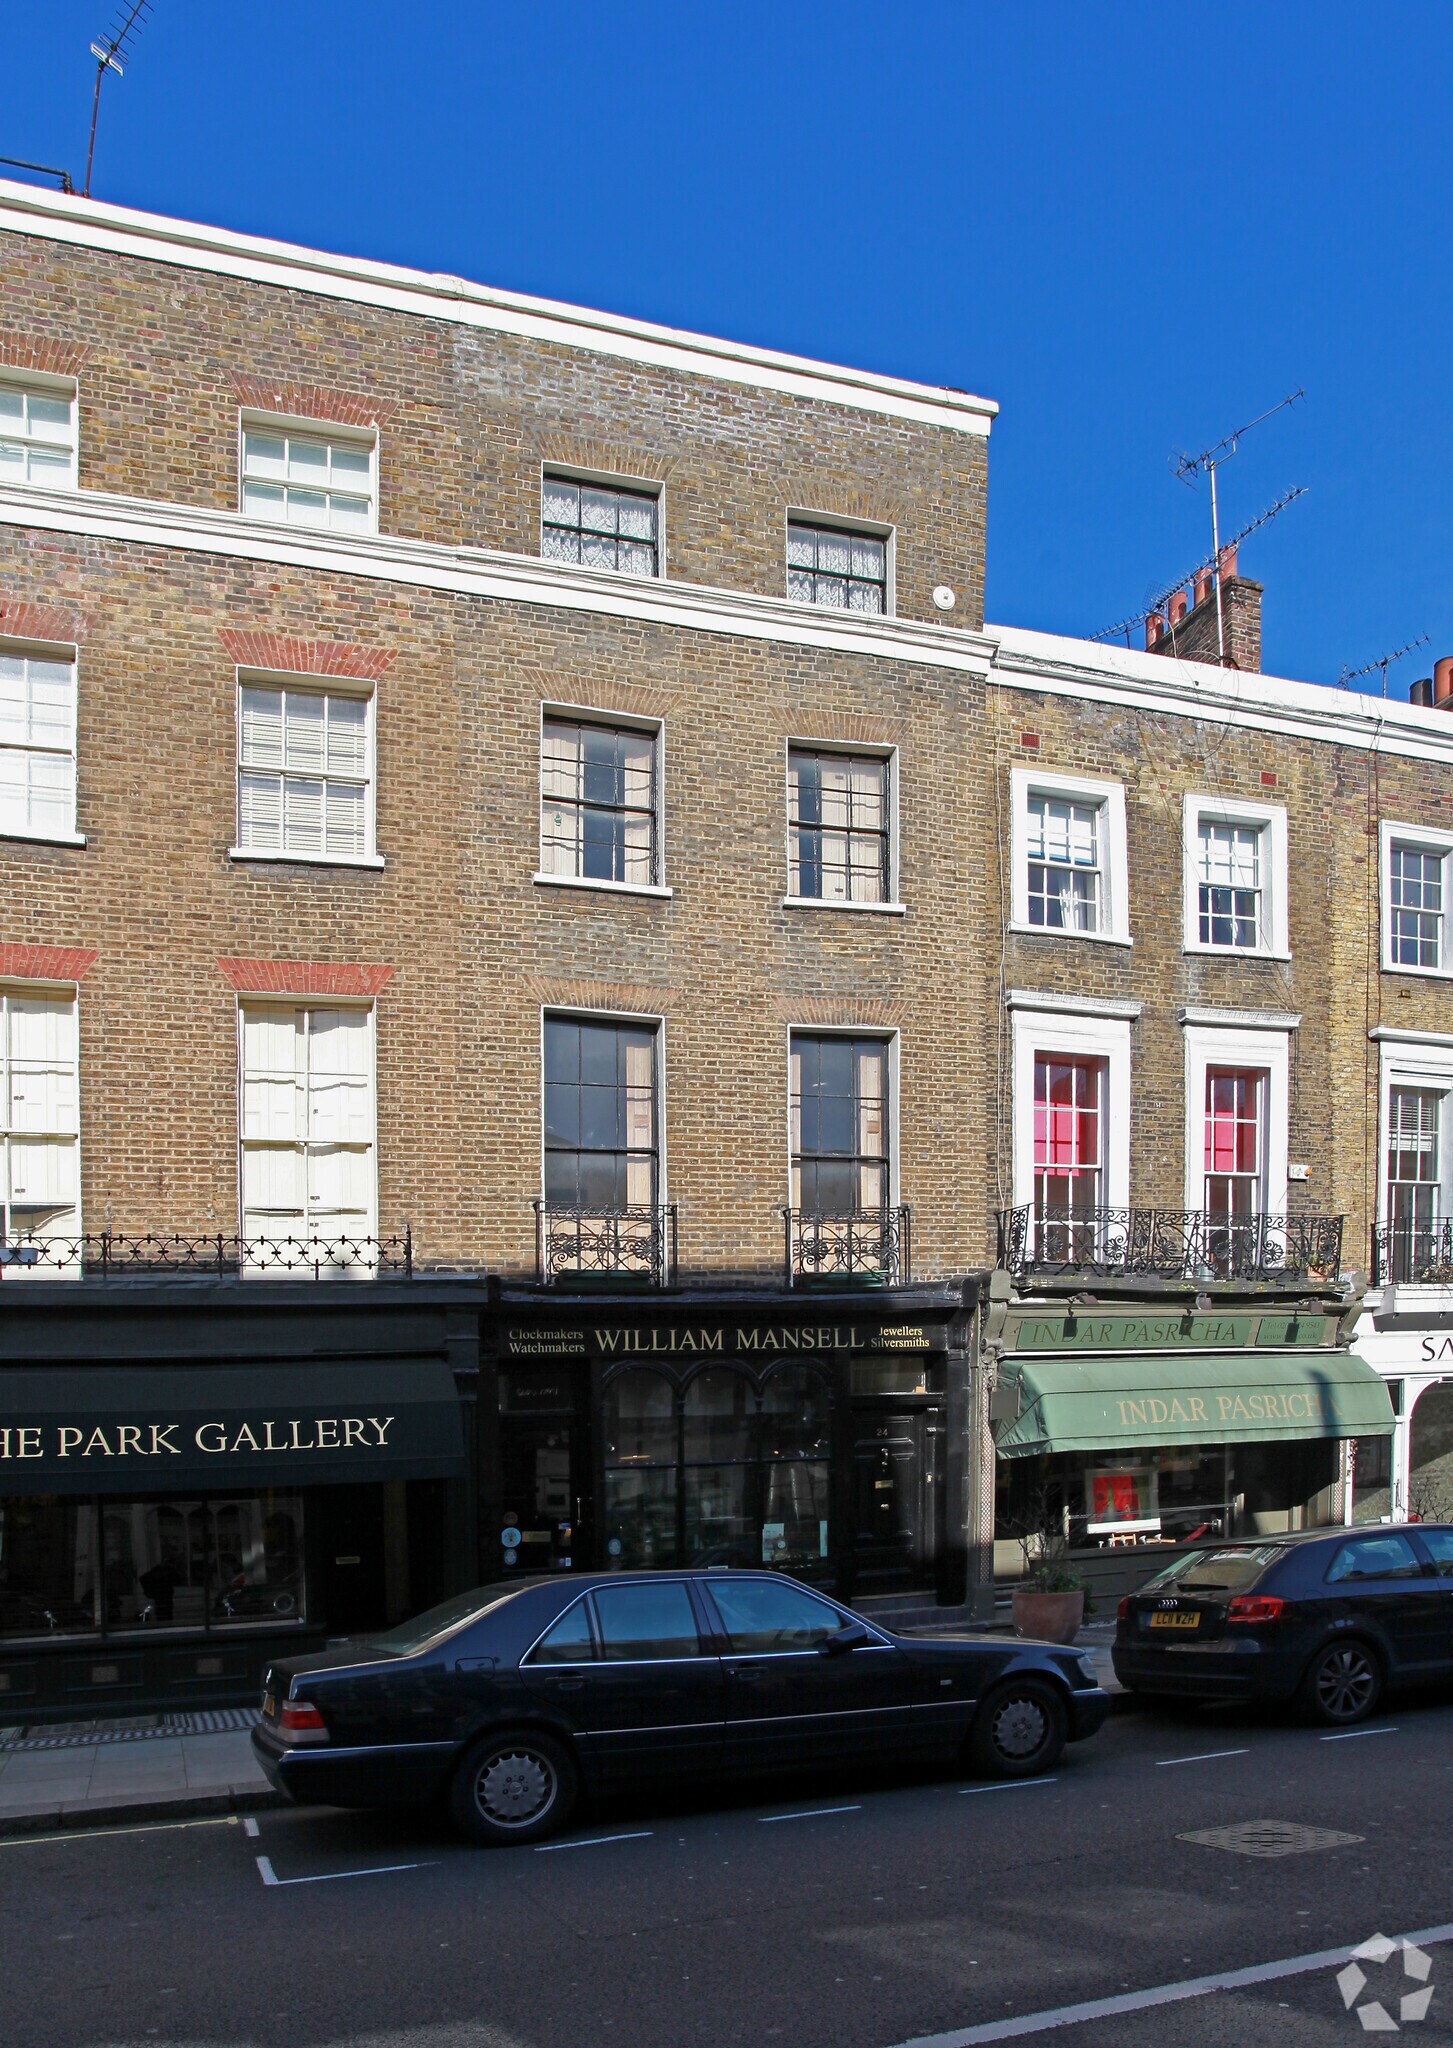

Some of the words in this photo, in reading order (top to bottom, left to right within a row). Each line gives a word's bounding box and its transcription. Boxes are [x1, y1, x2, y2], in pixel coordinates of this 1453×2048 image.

[508, 1328, 584, 1340] Clockmakers
[594, 1328, 724, 1351] WILLIAM
[735, 1327, 865, 1350] MANSELL
[878, 1325, 923, 1337] Jewellers
[1120, 1321, 1236, 1342] PASRICHA
[509, 1341, 585, 1354] Watchmakers
[870, 1337, 930, 1348] Silversmiths
[1116, 1397, 1209, 1425] INDAR
[1216, 1393, 1343, 1420] PASRICHA
[57, 1424, 182, 1457] PARK
[195, 1417, 395, 1453] GALLERY
